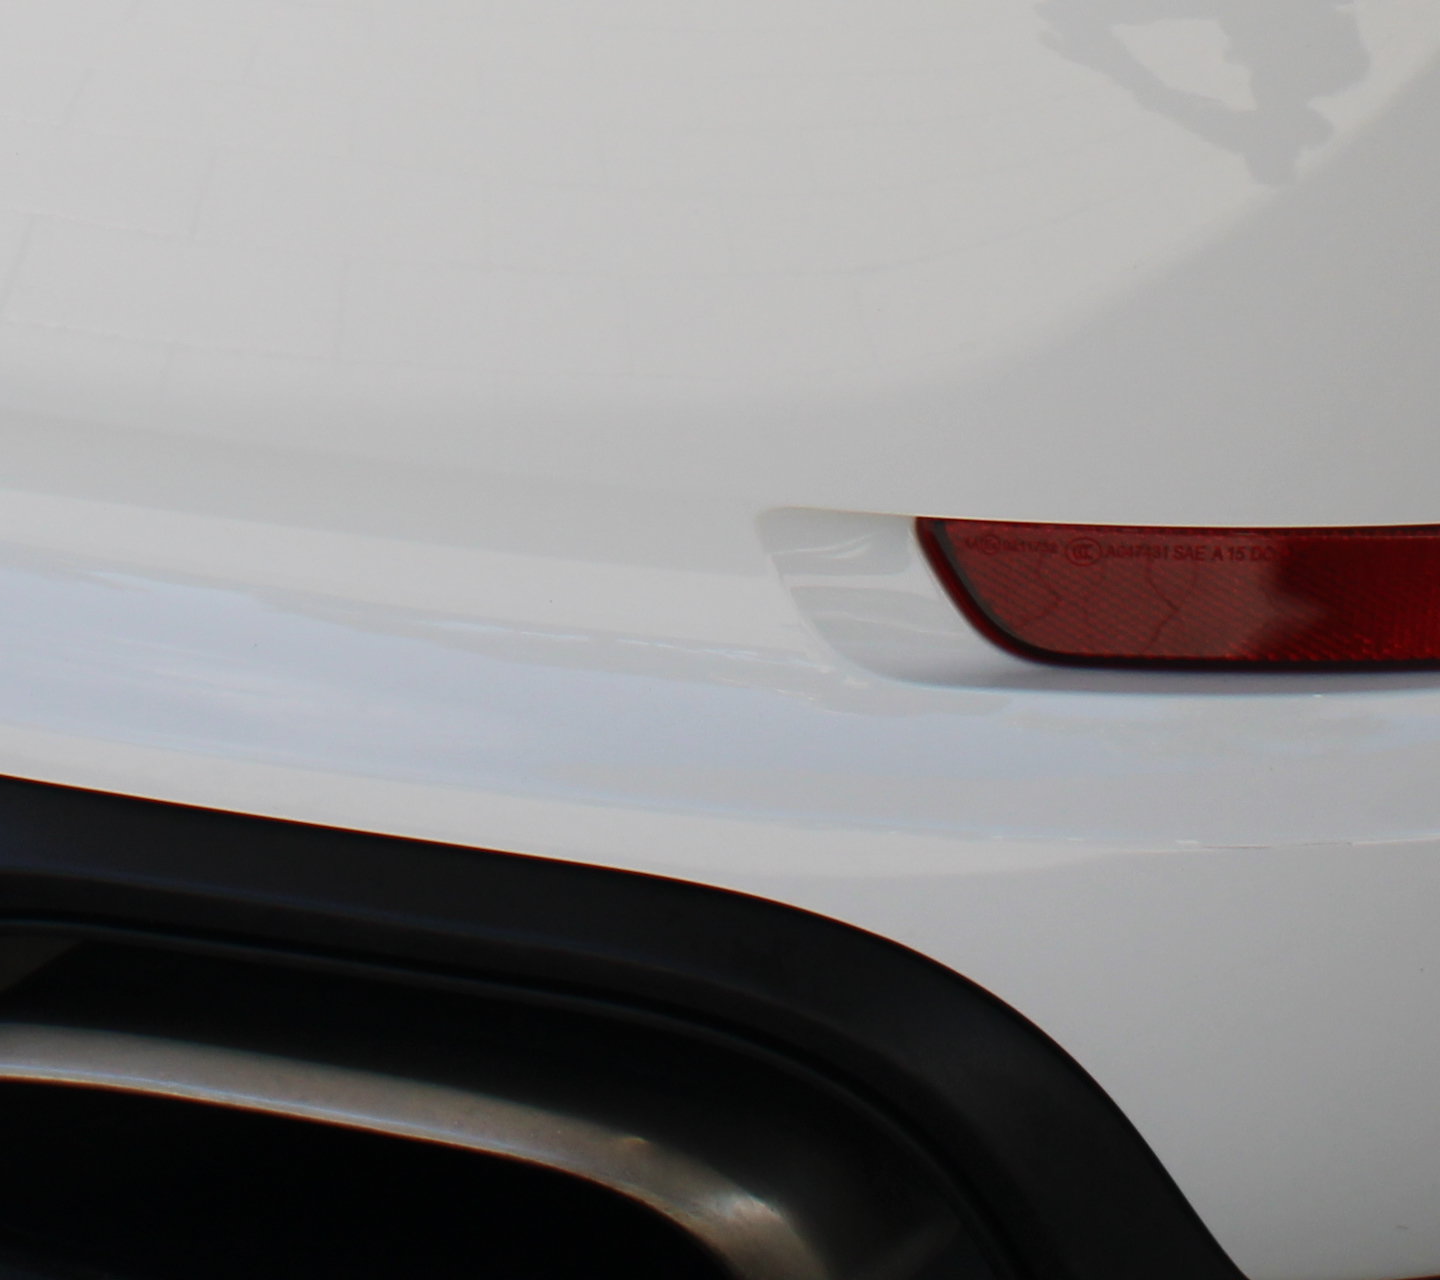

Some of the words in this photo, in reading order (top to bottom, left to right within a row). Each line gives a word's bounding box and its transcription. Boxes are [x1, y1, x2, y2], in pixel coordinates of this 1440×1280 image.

[1172, 545, 1206, 561] SAE
[1211, 545, 1224, 561] A
[1228, 545, 1246, 561] 15
